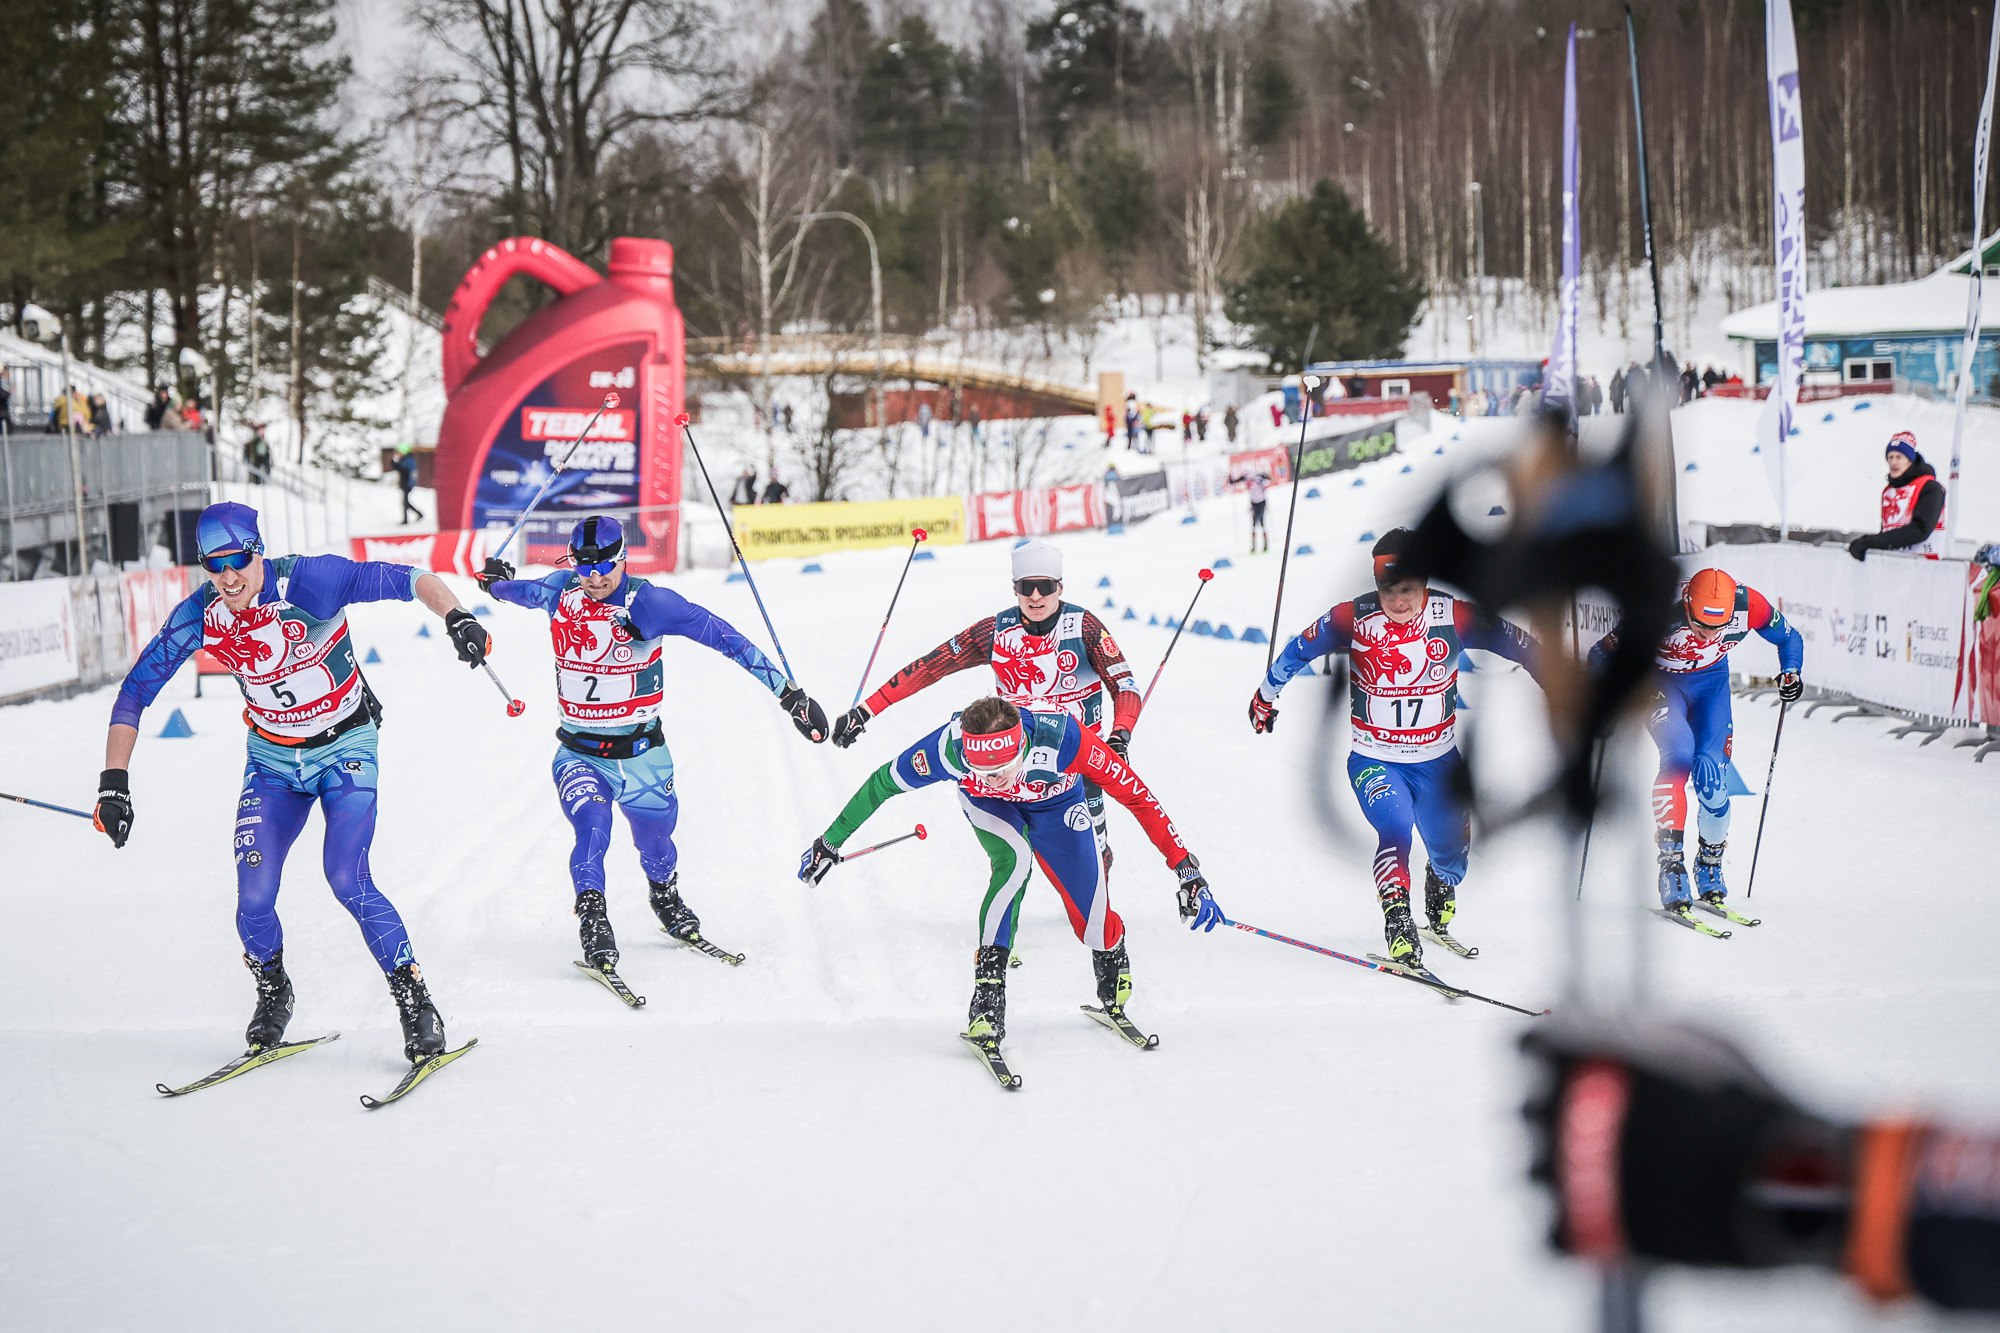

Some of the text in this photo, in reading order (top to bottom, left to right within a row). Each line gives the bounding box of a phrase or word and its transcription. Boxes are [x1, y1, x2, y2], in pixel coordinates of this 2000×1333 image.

[529, 412, 627, 438] TEBOIL
[287, 622, 300, 637] 30
[617, 649, 629, 658] КЛ
[1430, 642, 1444, 655] 30
[279, 665, 295, 677] ski
[296, 640, 335, 672] marathon
[344, 650, 355, 668] 5
[1060, 654, 1073, 667] 30
[563, 661, 650, 675] Demino ski maratho
[1433, 668, 1444, 678] КЛ
[583, 675, 600, 702] 2
[653, 674, 660, 691] 2
[1411, 686, 1424, 695] ski
[270, 680, 297, 708] 5
[262, 699, 332, 722] Демино
[566, 703, 628, 718] Демино
[1390, 698, 1424, 728] 17
[966, 735, 1015, 752] LUKOIL
